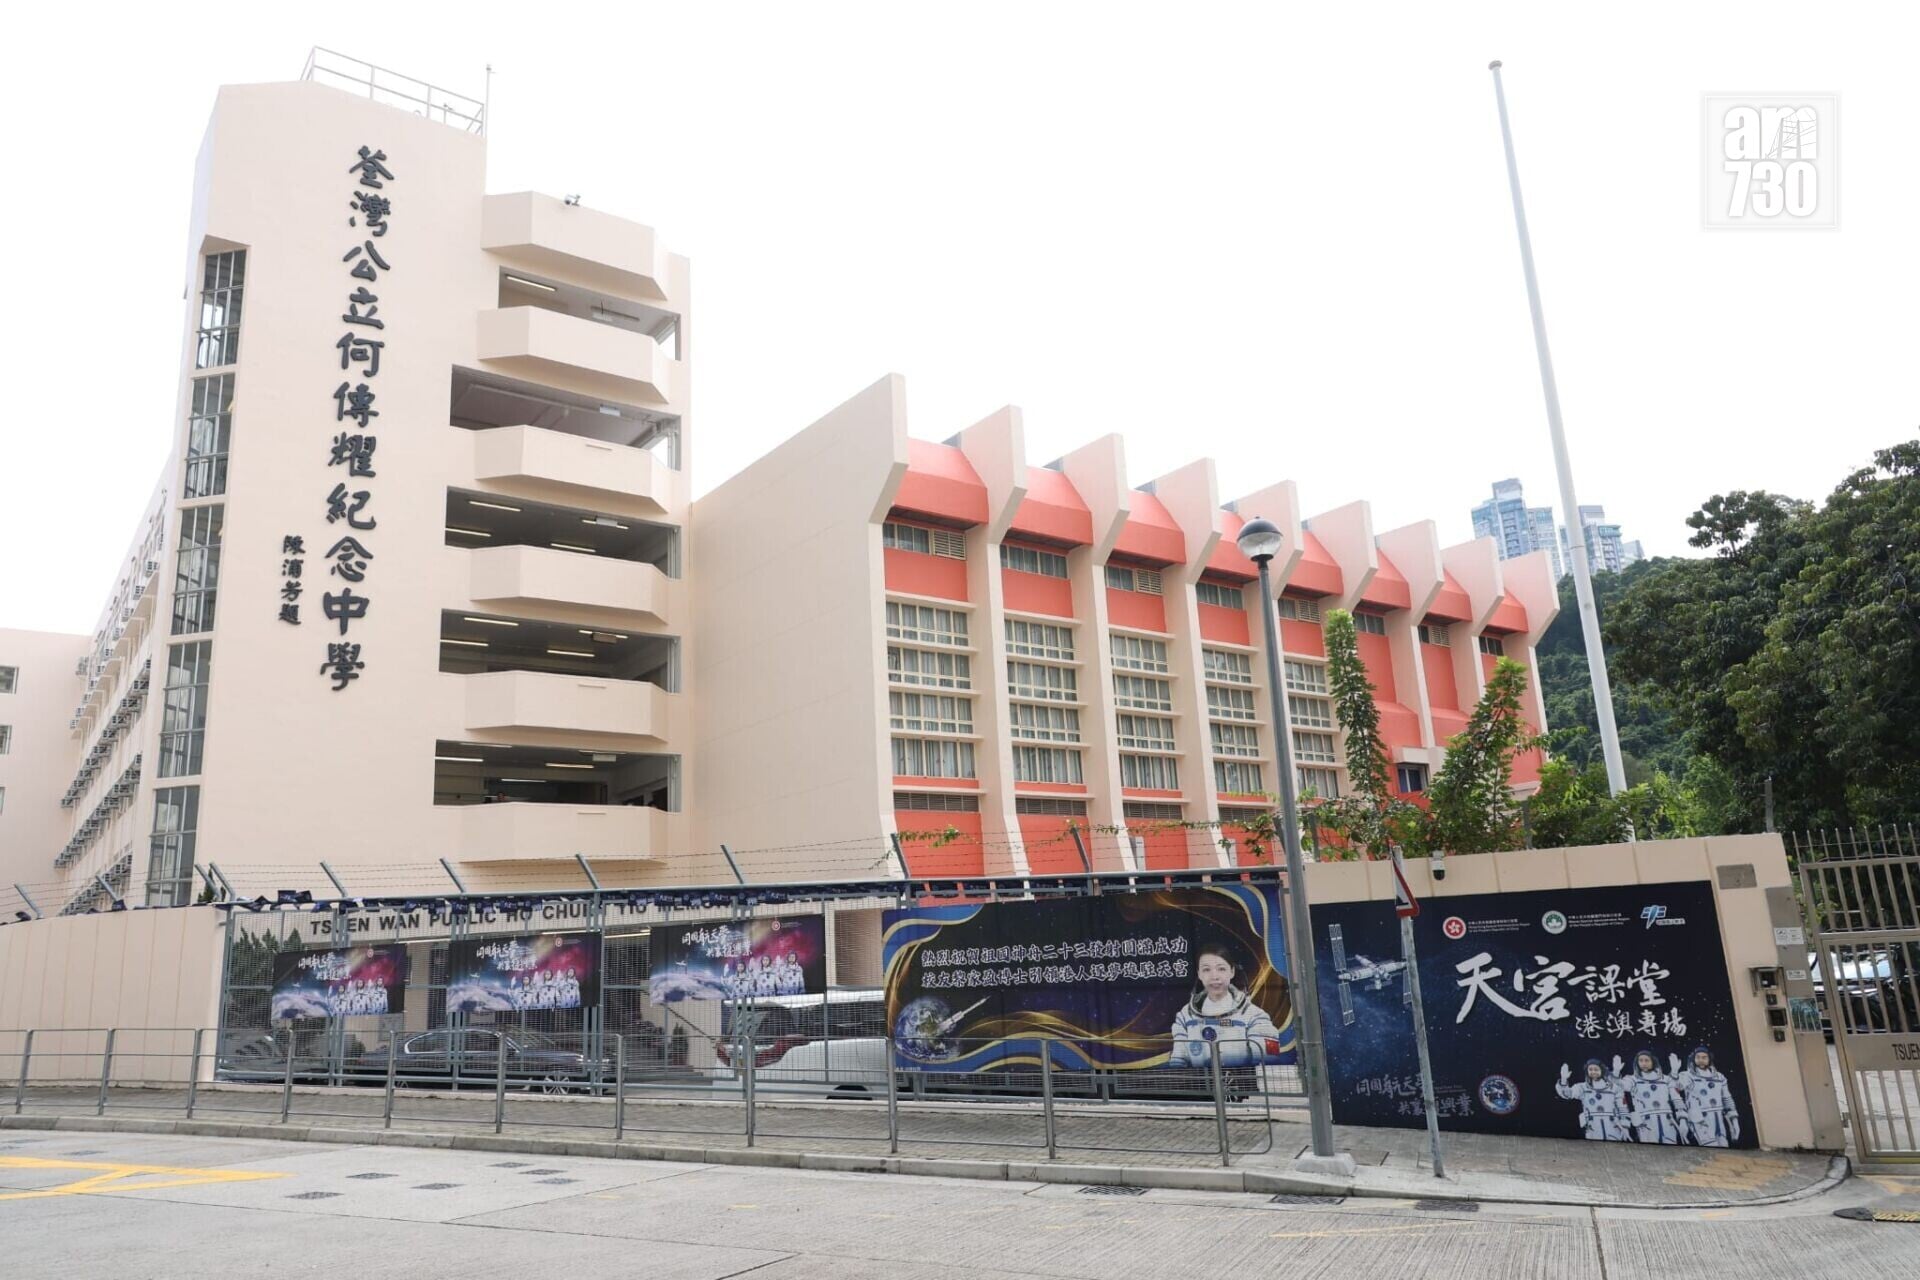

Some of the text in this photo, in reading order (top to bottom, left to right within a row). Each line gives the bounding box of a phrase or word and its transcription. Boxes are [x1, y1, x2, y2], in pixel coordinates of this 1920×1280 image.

[319, 146, 395, 692] 荃灣公立何傳耀紀念中學
[310, 916, 370, 936] TSEN
[379, 911, 419, 931] WAN
[1455, 952, 1671, 1024] 天宮課堂
[1575, 1007, 1688, 1039] 港澳專場
